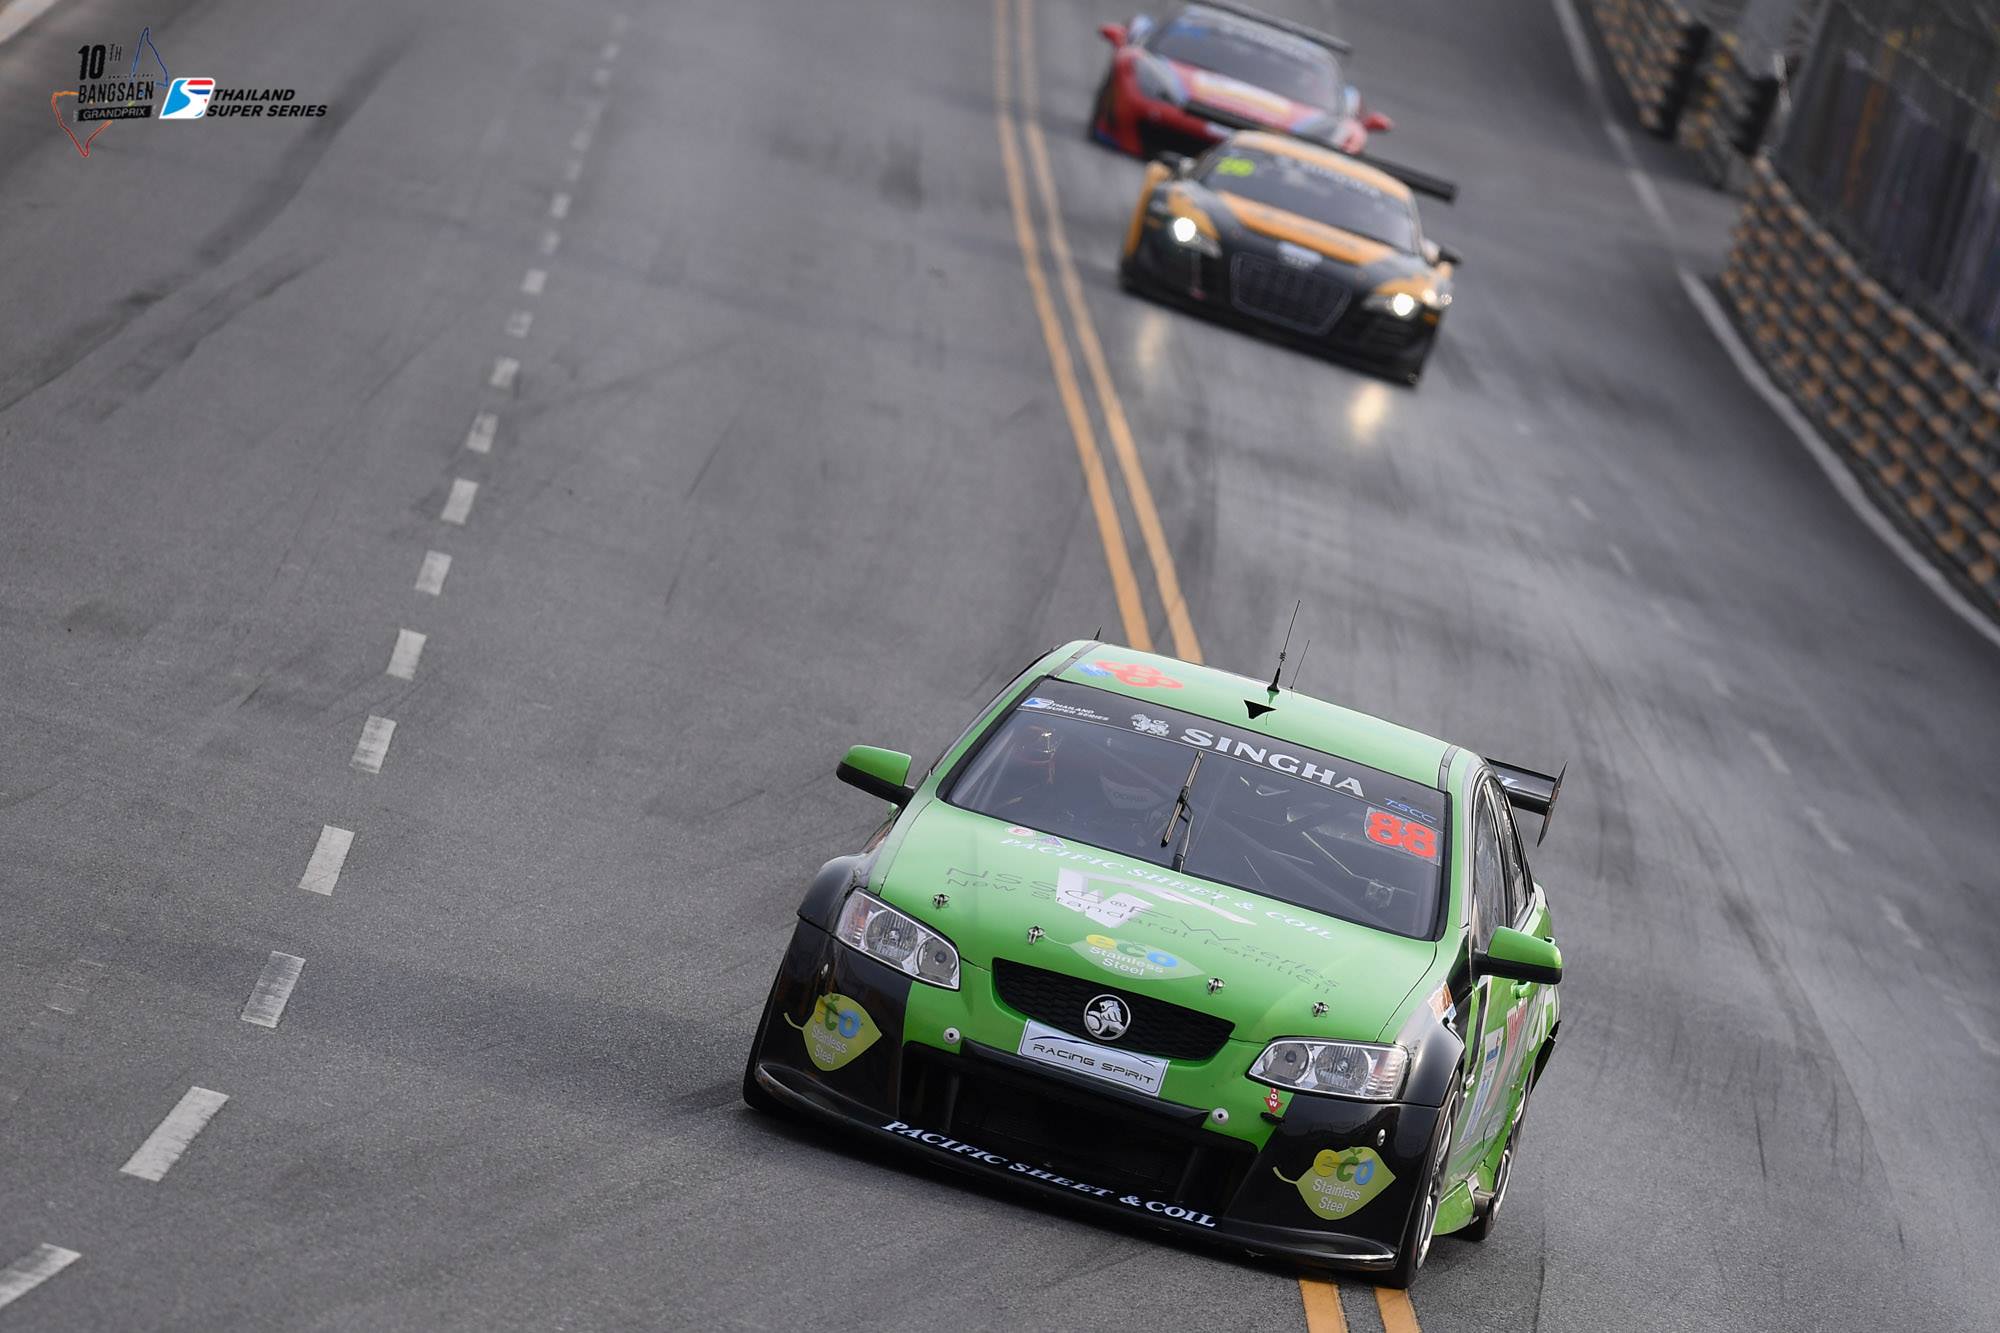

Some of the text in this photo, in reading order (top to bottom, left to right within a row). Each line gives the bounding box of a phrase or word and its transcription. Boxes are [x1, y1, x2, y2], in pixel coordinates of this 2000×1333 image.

[1180, 728, 1365, 797] SINGHA
[1384, 797, 1437, 824] TSCC
[1367, 810, 1437, 859] 88
[1000, 838, 1336, 940] PACIFIC SHEET & COIL
[1089, 946, 1164, 974] Stainless
[1102, 958, 1145, 977] Steel
[811, 1024, 848, 1054] Stainless
[815, 1044, 834, 1064] Steel
[881, 1120, 1217, 1228] PACIFIC SHEET & COIL
[1312, 1178, 1361, 1201] Stainless
[1318, 1196, 1347, 1213] Steel
